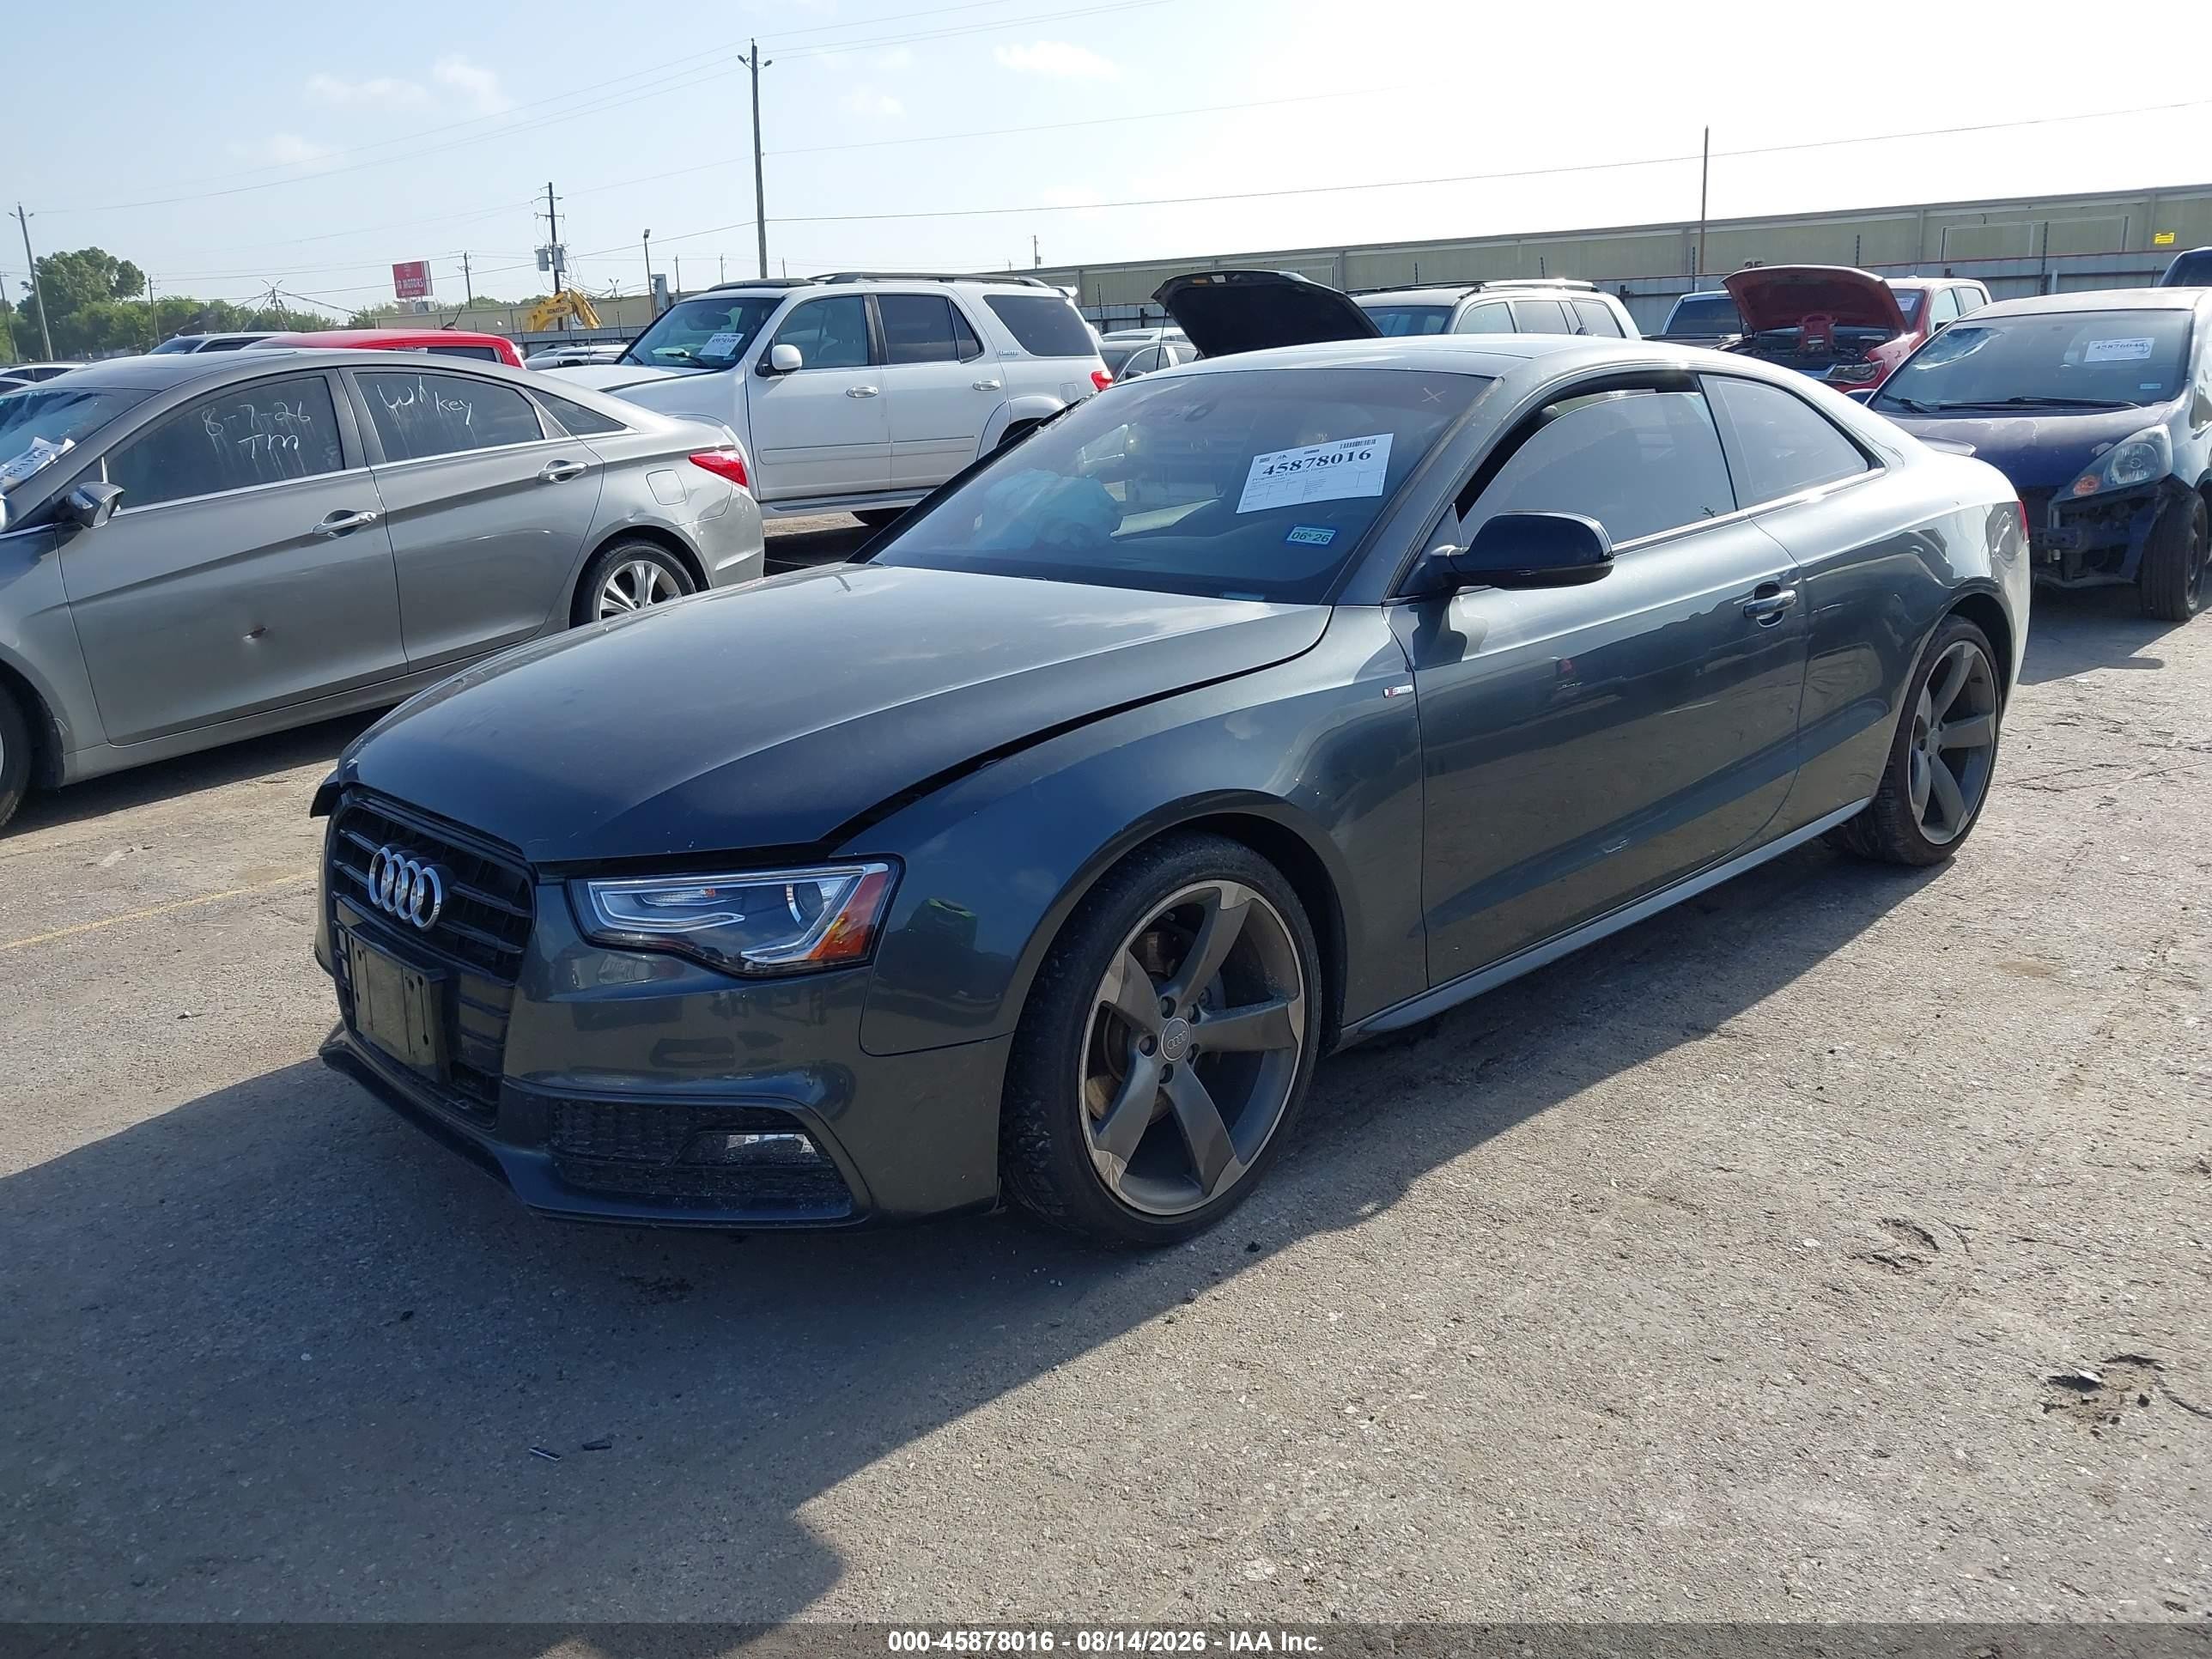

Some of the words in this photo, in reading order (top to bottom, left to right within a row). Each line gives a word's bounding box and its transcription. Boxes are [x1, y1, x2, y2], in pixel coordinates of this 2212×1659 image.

[1262, 447, 1374, 476] 45878016
[1291, 532, 1309, 540] 06
[1312, 533, 1331, 543] 26
